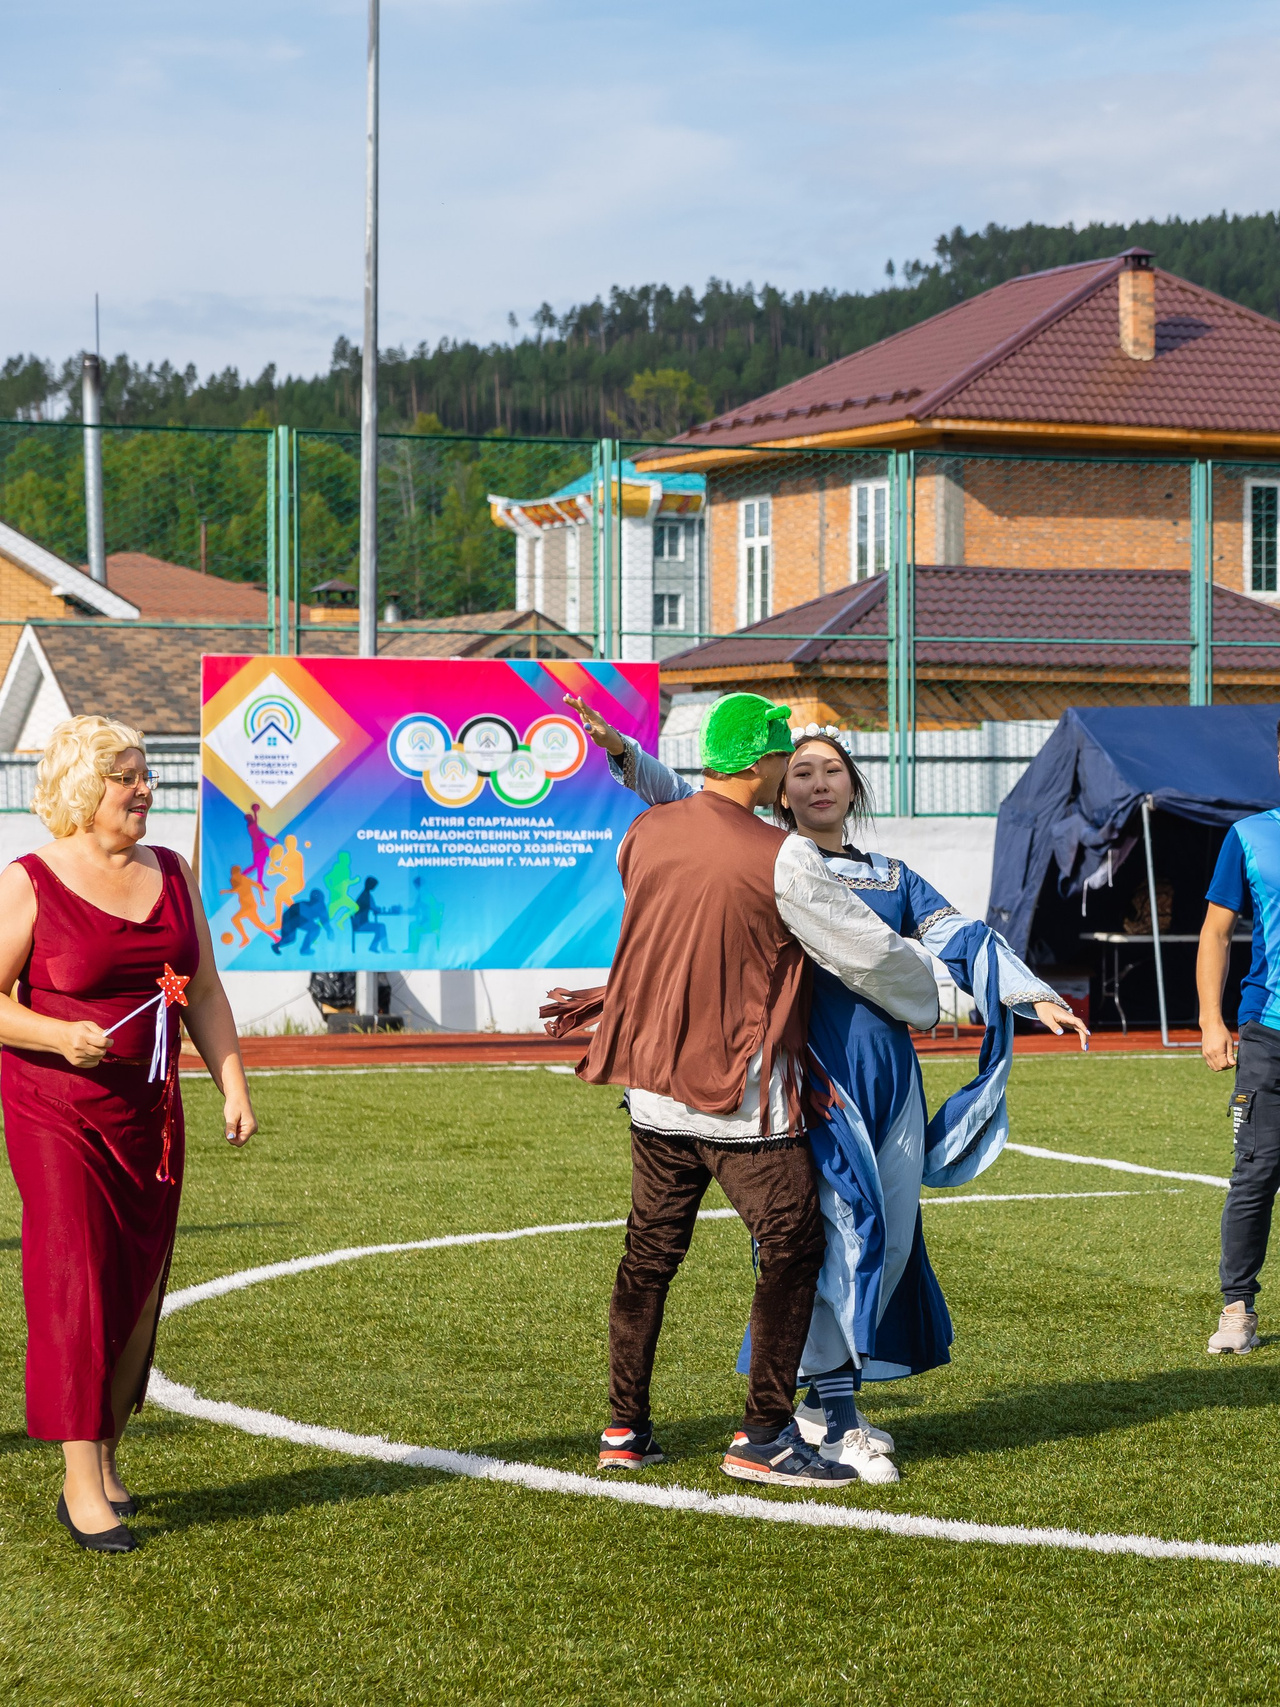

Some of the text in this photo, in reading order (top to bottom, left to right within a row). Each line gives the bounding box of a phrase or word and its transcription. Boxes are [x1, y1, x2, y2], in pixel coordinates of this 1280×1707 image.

[420, 816, 555, 828] ЛЕТНЯЯ СПАРТАКИАДА
[356, 827, 613, 841] СРЕДИ ПОДВЕДОМСТВЕННЫХ УЧРЕЖДЕНИЙ
[377, 841, 594, 855] КОМИТЕТА ГОРОДСКОГО ХОЗЯЙСТВА
[397, 856, 504, 868] АДМИНИСТРАЦИИ
[506, 857, 517, 867] Г.
